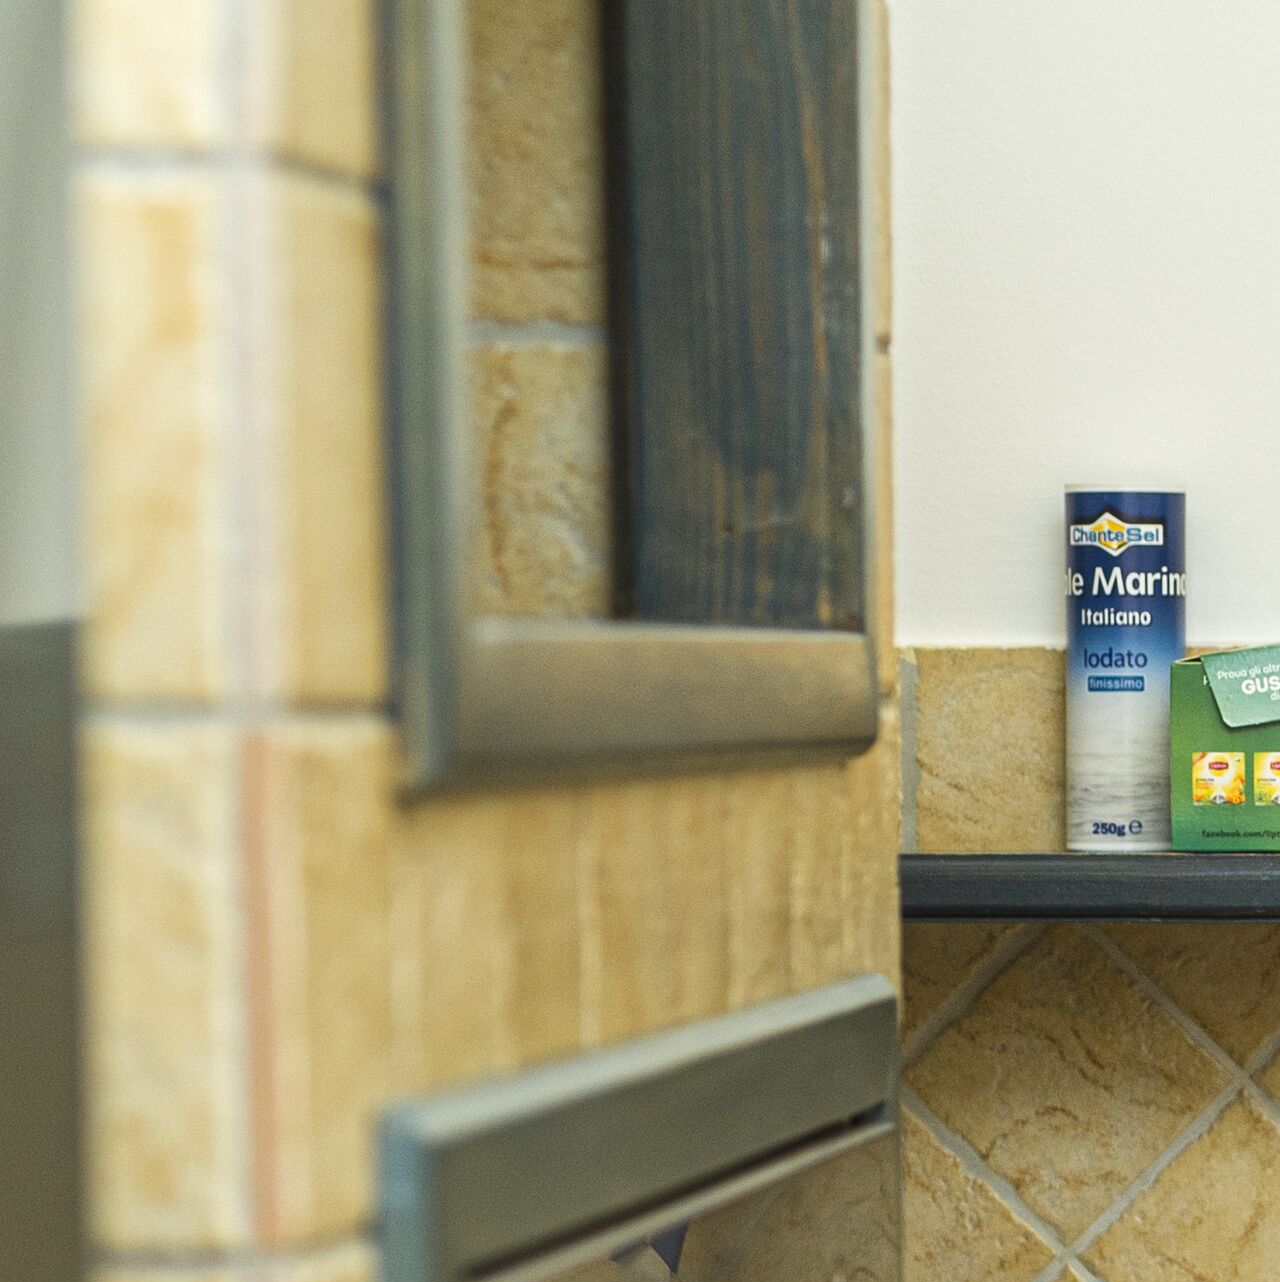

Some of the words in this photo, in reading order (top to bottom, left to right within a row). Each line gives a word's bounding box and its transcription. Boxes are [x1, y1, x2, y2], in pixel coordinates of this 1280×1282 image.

[1065, 566, 1084, 596] le
[1081, 607, 1152, 626] Italiano
[1083, 646, 1148, 668] Iodato
[1217, 668, 1247, 681] Prova
[1249, 664, 1262, 678] gli
[1090, 678, 1143, 690] finissimo
[1270, 690, 1280, 701] di
[1092, 822, 1126, 837] 250g
